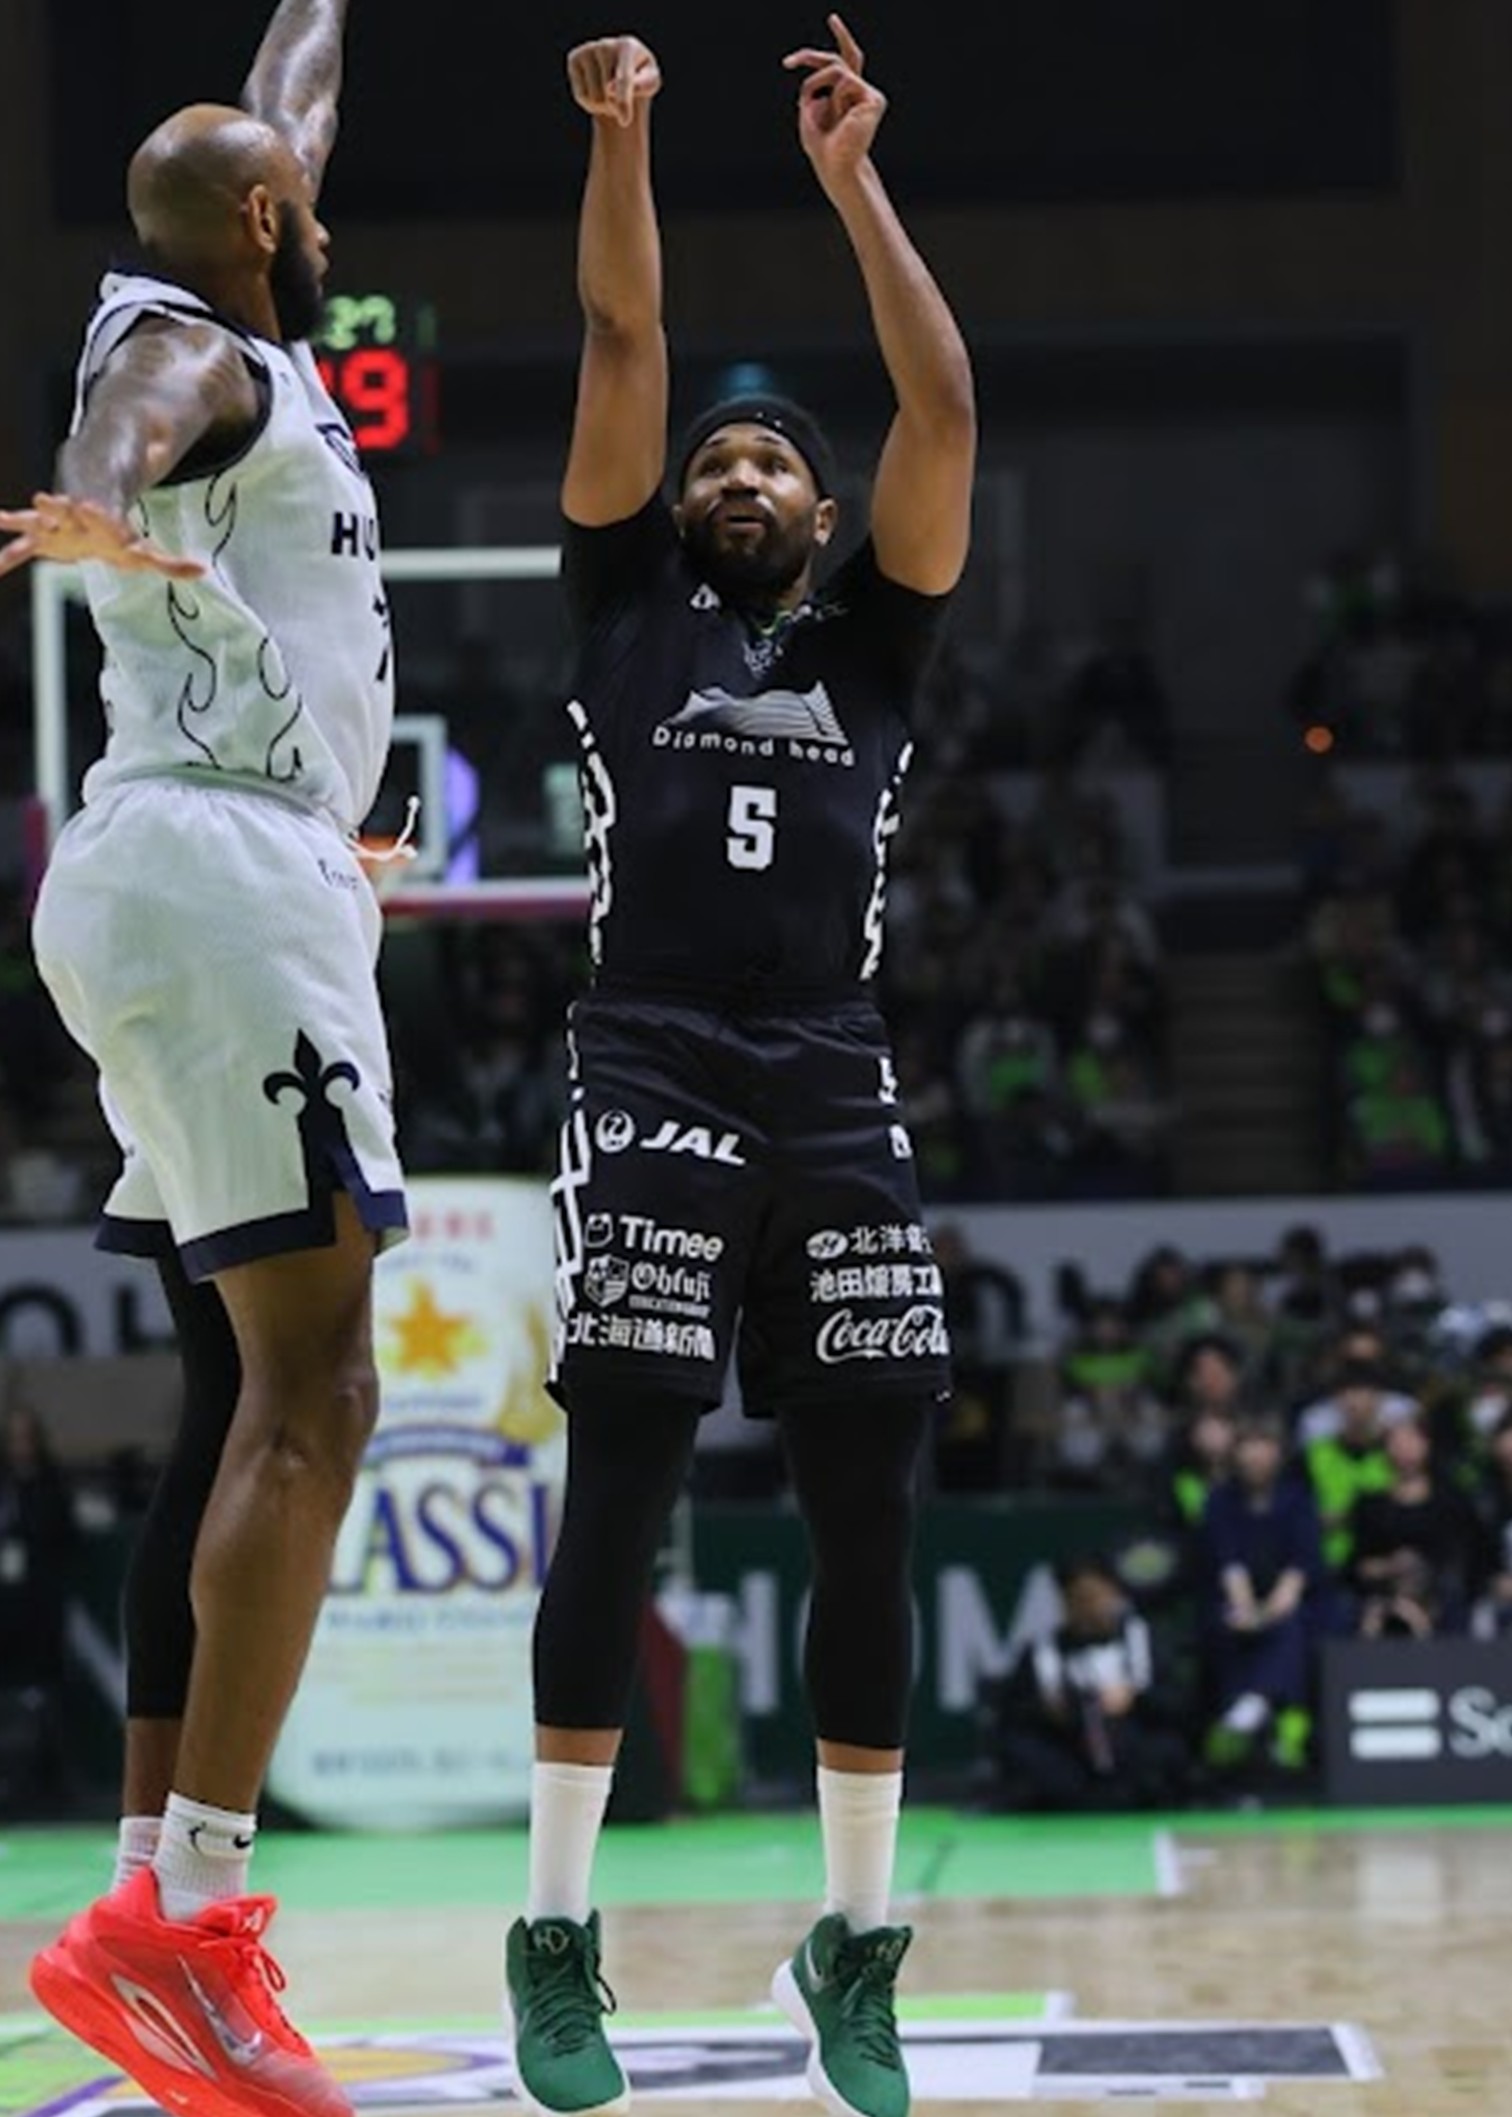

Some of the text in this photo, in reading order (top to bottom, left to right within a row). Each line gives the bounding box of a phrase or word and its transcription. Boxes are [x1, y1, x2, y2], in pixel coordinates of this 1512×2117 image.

[652, 726, 855, 767] Diamond head
[726, 785, 778, 871] 5
[640, 1121, 746, 1166] JAL
[619, 1215, 724, 1262] Timee
[328, 1481, 550, 1595] ASSI
